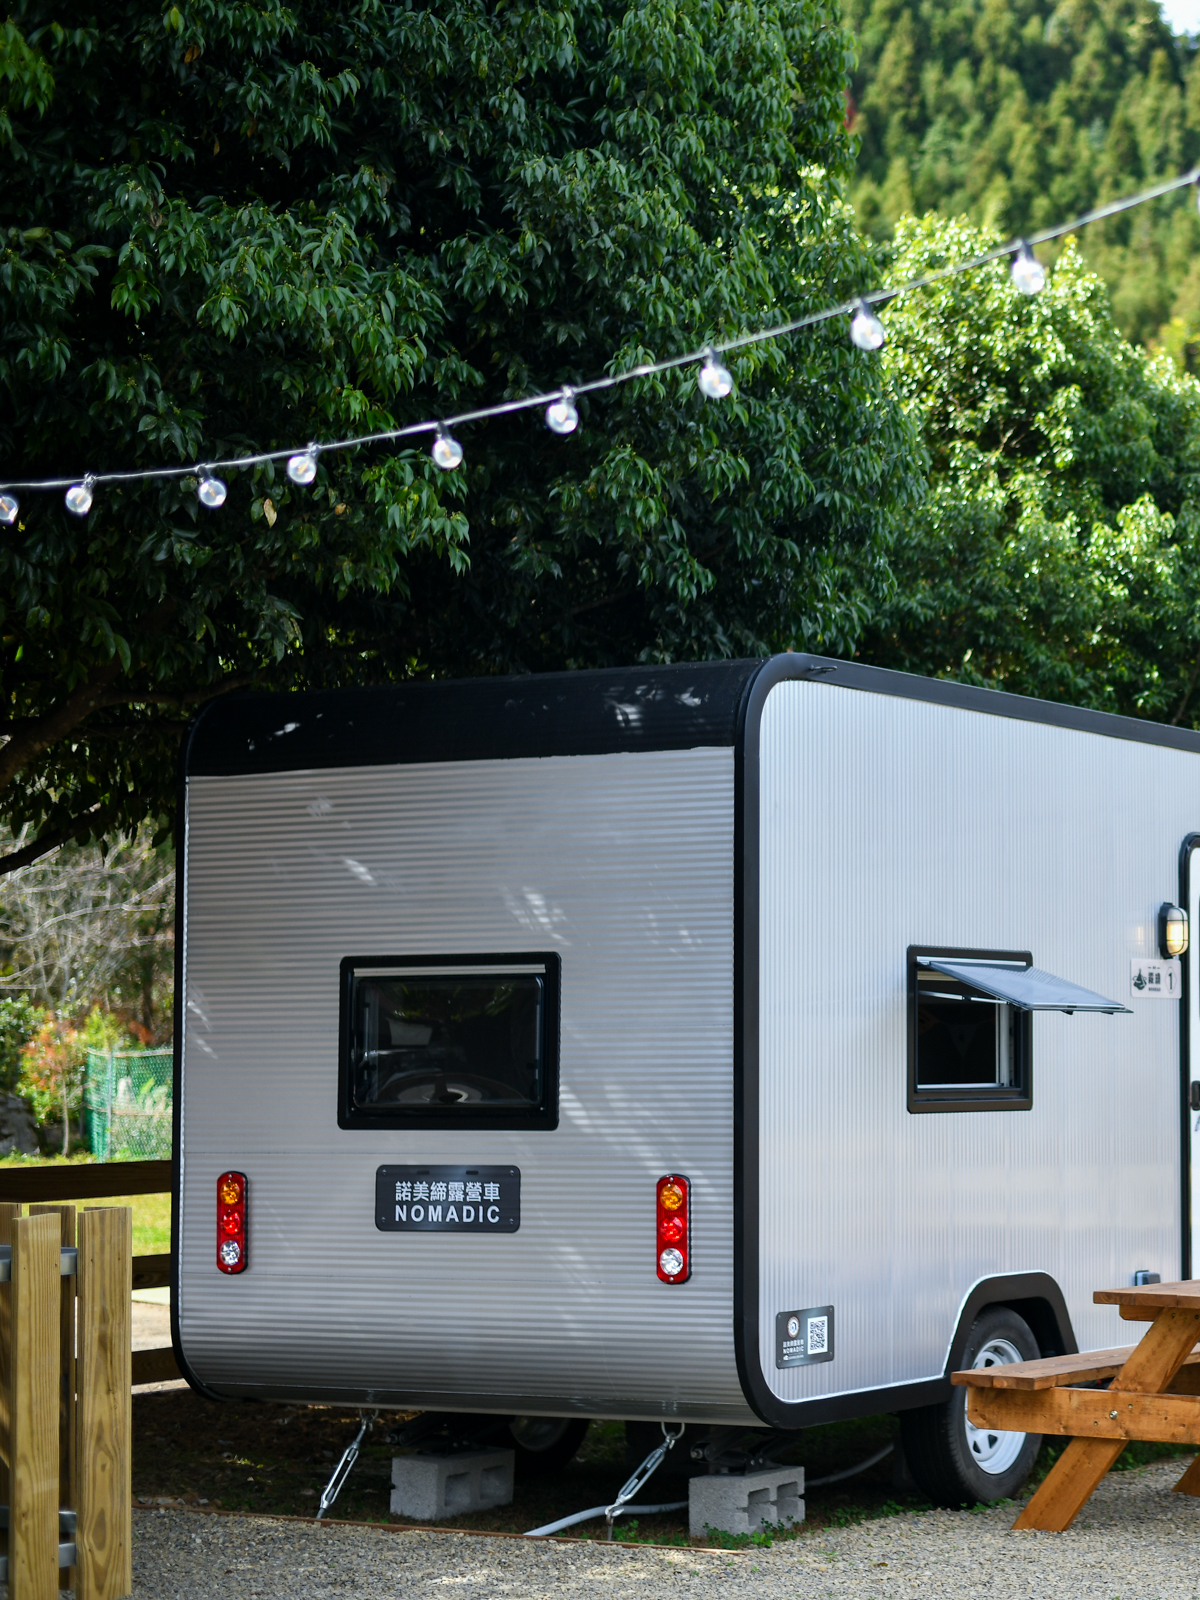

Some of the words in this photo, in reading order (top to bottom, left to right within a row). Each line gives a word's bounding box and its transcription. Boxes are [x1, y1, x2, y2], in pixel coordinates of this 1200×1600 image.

[1168, 972, 1173, 990] 1
[395, 1181, 501, 1202] 諾美締露營車
[395, 1205, 500, 1223] NOMADIC
[783, 1346, 804, 1354] NOMADIC
